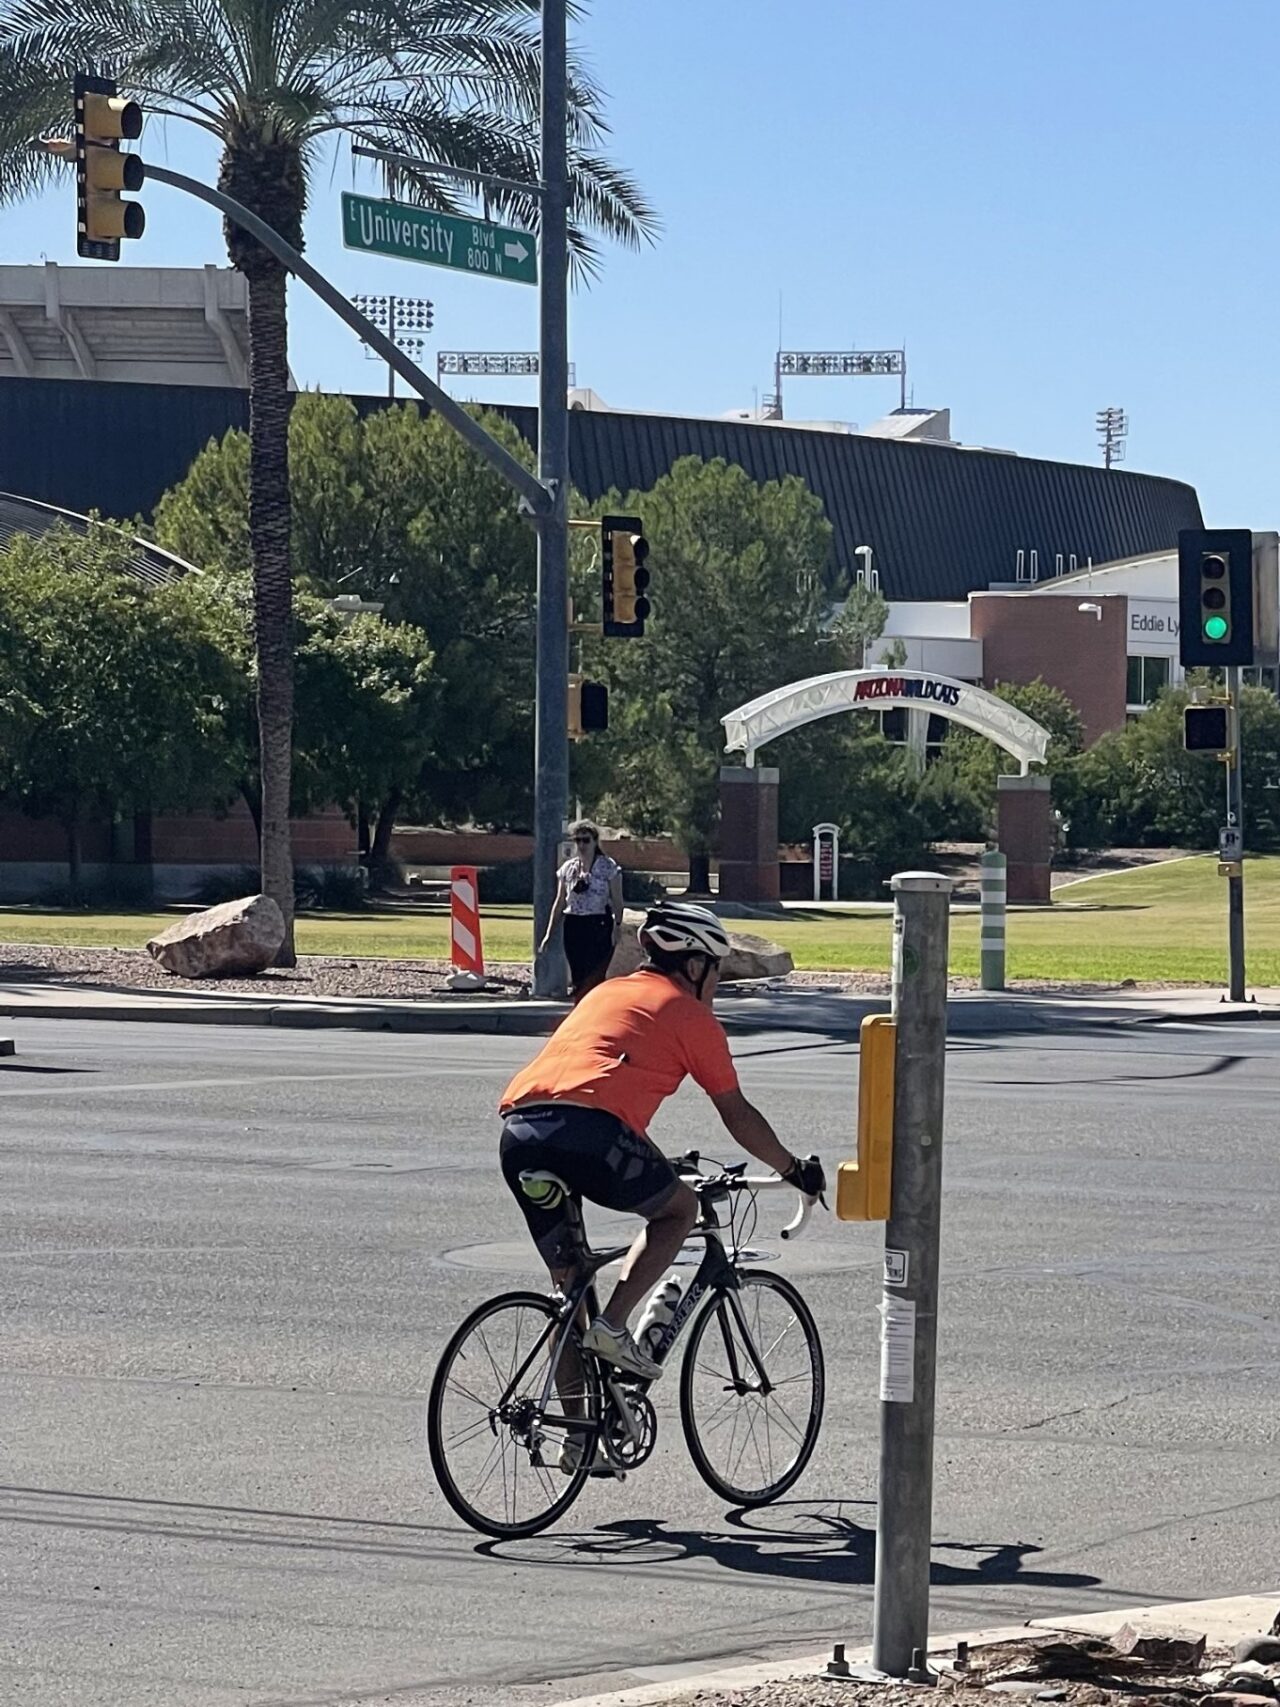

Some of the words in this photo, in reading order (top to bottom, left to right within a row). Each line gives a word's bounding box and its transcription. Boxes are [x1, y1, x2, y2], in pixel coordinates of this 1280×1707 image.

[350, 200, 356, 221] E
[360, 204, 454, 263] University
[472, 225, 495, 249] Blvd
[467, 247, 487, 270] 800
[494, 253, 503, 274] N
[1131, 614, 1164, 631] Eddie
[660, 1282, 704, 1349] TREK
